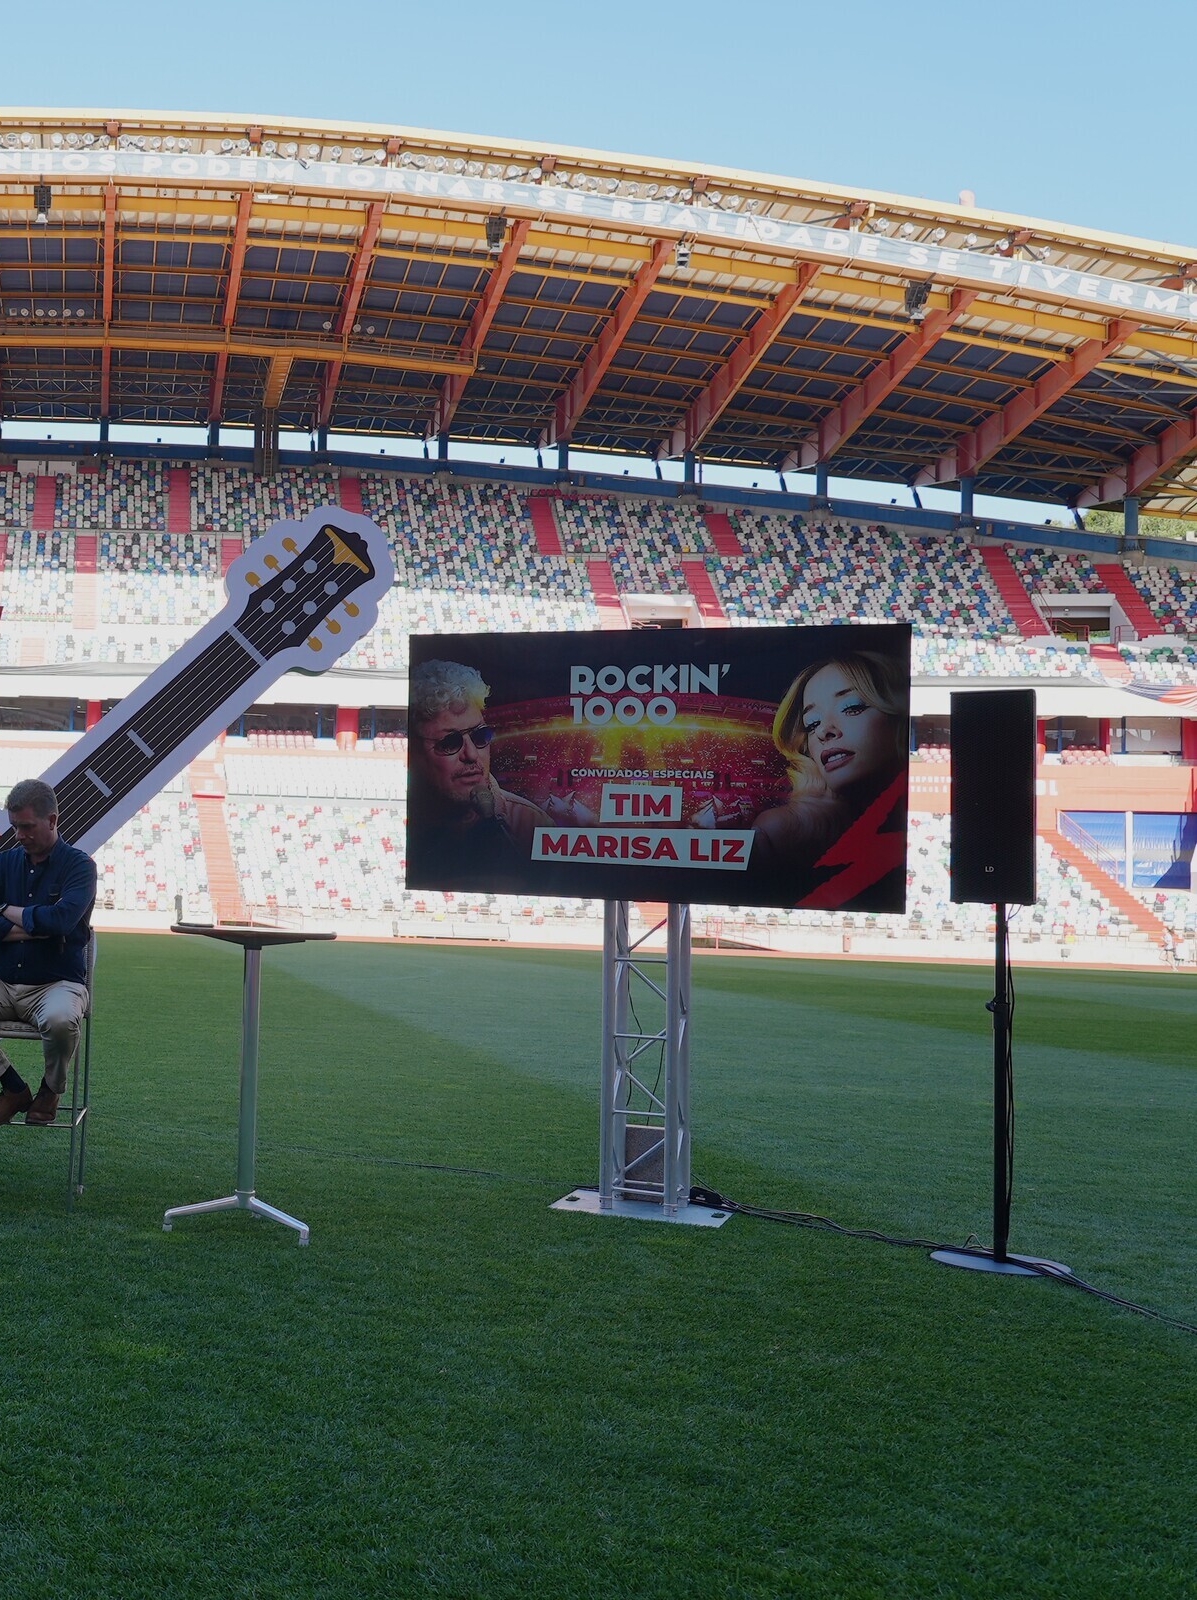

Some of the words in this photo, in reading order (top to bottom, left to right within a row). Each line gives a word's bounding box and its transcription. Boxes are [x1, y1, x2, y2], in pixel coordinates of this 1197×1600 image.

[143, 154, 295, 181] PODEM
[322, 165, 586, 212] TORNAR-SE
[611, 201, 881, 257] REALIDADE
[907, 246, 961, 271] SE
[570, 663, 731, 696] ROCKIN'
[570, 696, 677, 726] 1000
[570, 768, 649, 779] CONVIDADOS
[652, 769, 715, 780] ESPECIAIS
[609, 793, 672, 817] TIM
[541, 833, 679, 861] MARISA
[690, 838, 746, 864] LIZ
